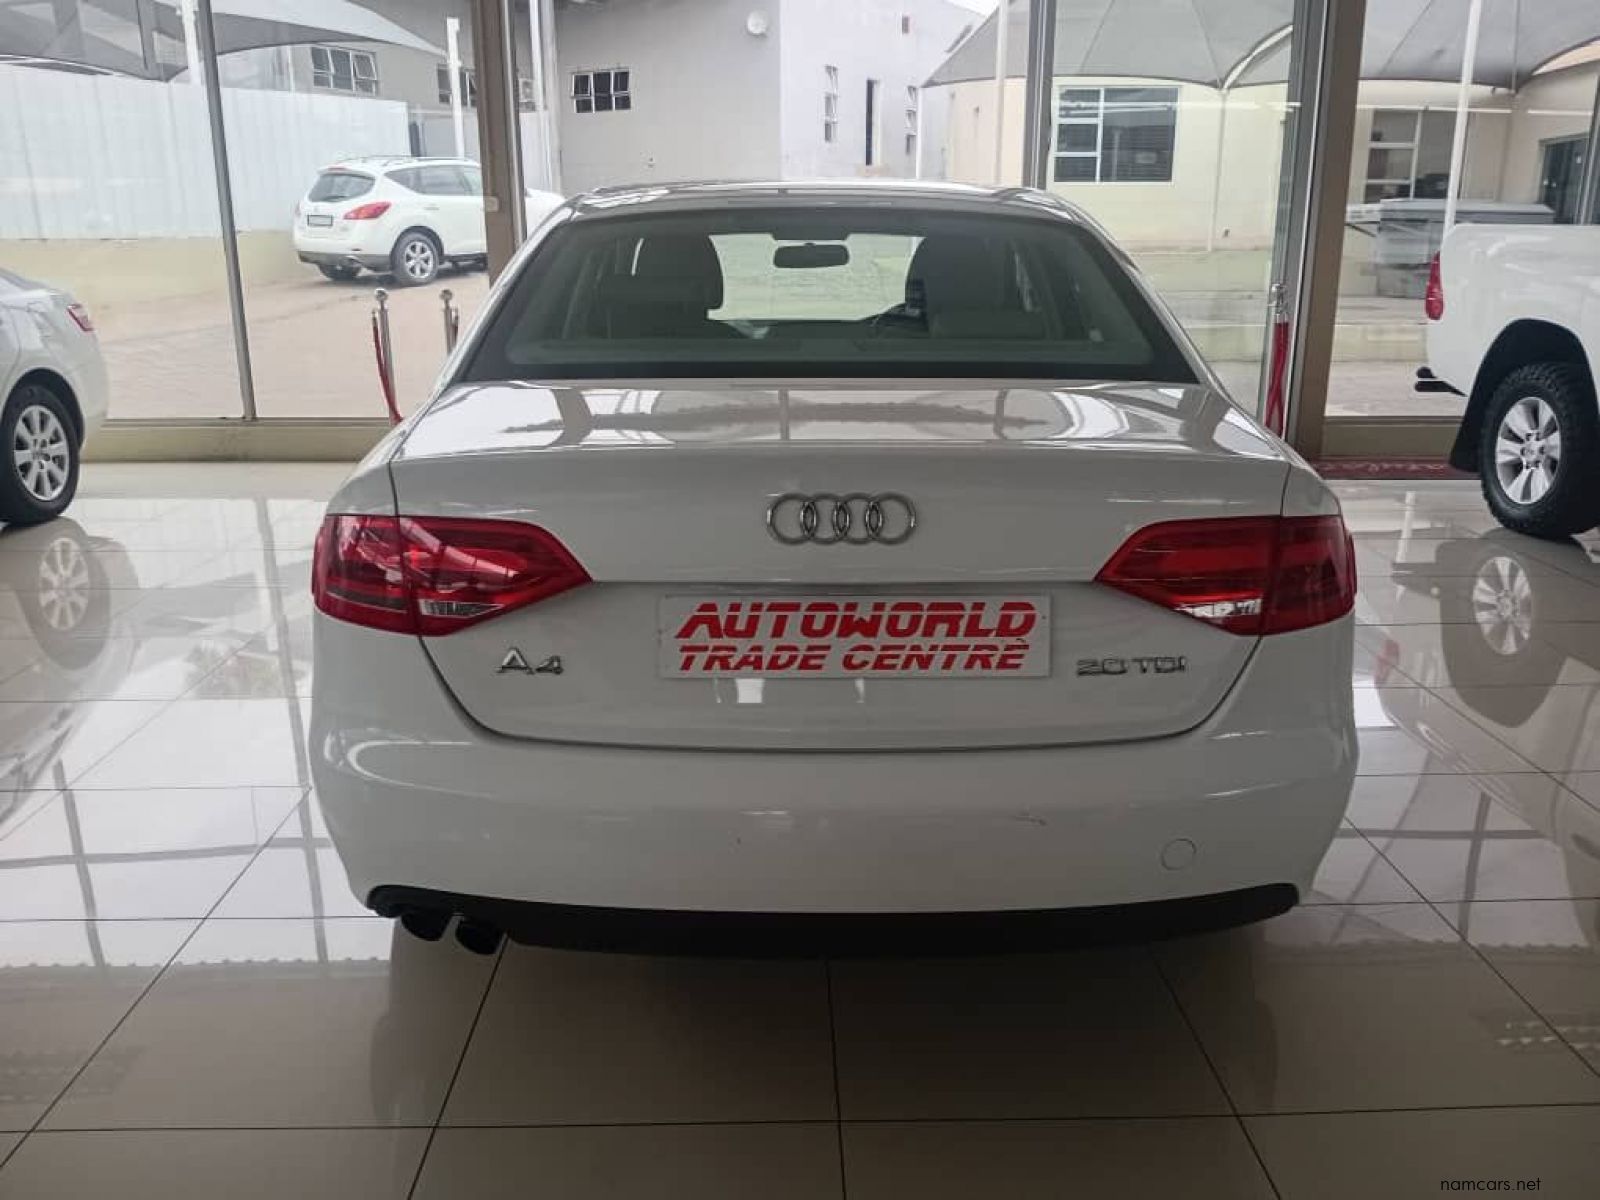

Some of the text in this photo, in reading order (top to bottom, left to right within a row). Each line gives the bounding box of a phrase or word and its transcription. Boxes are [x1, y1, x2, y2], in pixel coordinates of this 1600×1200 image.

[674, 602, 1037, 639] AUTOWORLD
[496, 647, 564, 676] A4
[680, 644, 1030, 671] TRADE CENTRE
